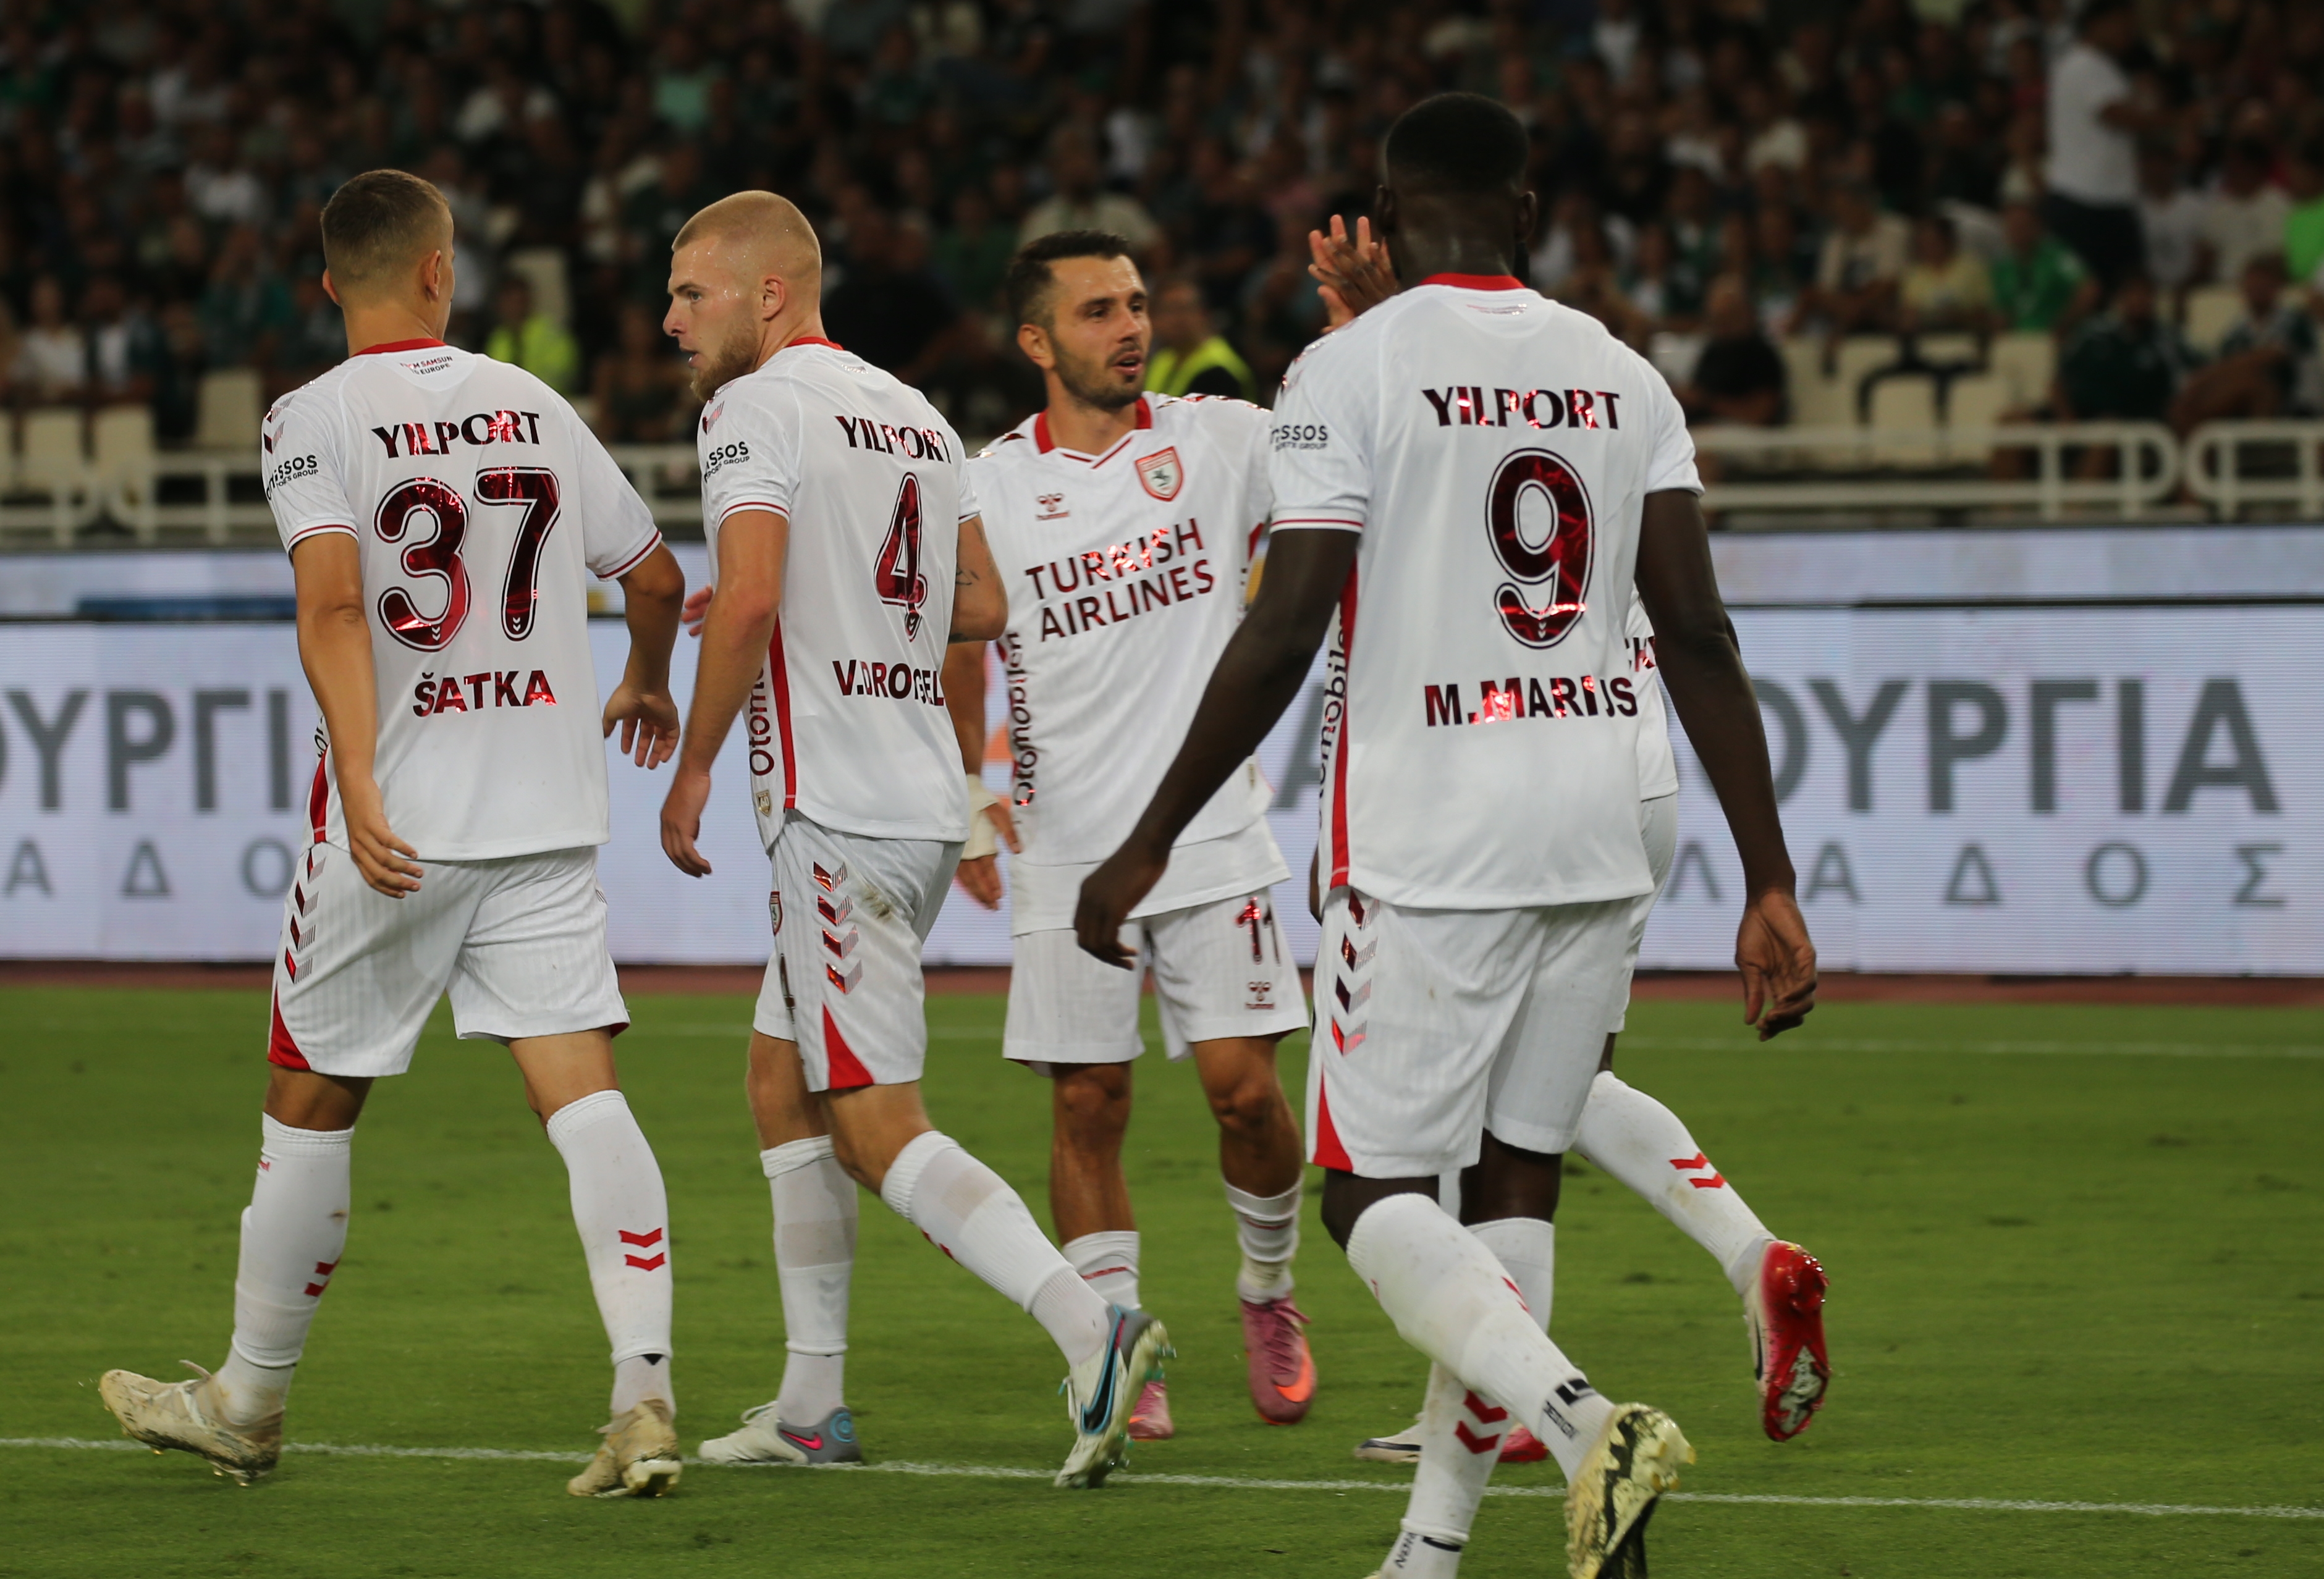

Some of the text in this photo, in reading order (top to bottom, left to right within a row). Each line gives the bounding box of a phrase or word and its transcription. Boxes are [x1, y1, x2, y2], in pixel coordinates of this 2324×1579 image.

[420, 363, 450, 374] EUROPE
[421, 355, 453, 367] SAMSUN
[371, 409, 541, 459] YILPORT
[1422, 387, 1620, 431] YILPORT
[723, 456, 750, 465] GROUP
[834, 415, 952, 465] YILPORT
[292, 469, 319, 479] GROUP
[374, 466, 560, 652] 37
[874, 471, 927, 642] 4
[1025, 517, 1204, 600] TURKISH
[1485, 447, 1595, 650] 9
[1041, 559, 1215, 642] AIRLINES
[412, 670, 557, 717] ŠATKA
[0, 688, 291, 812] ΥΡΓΙ
